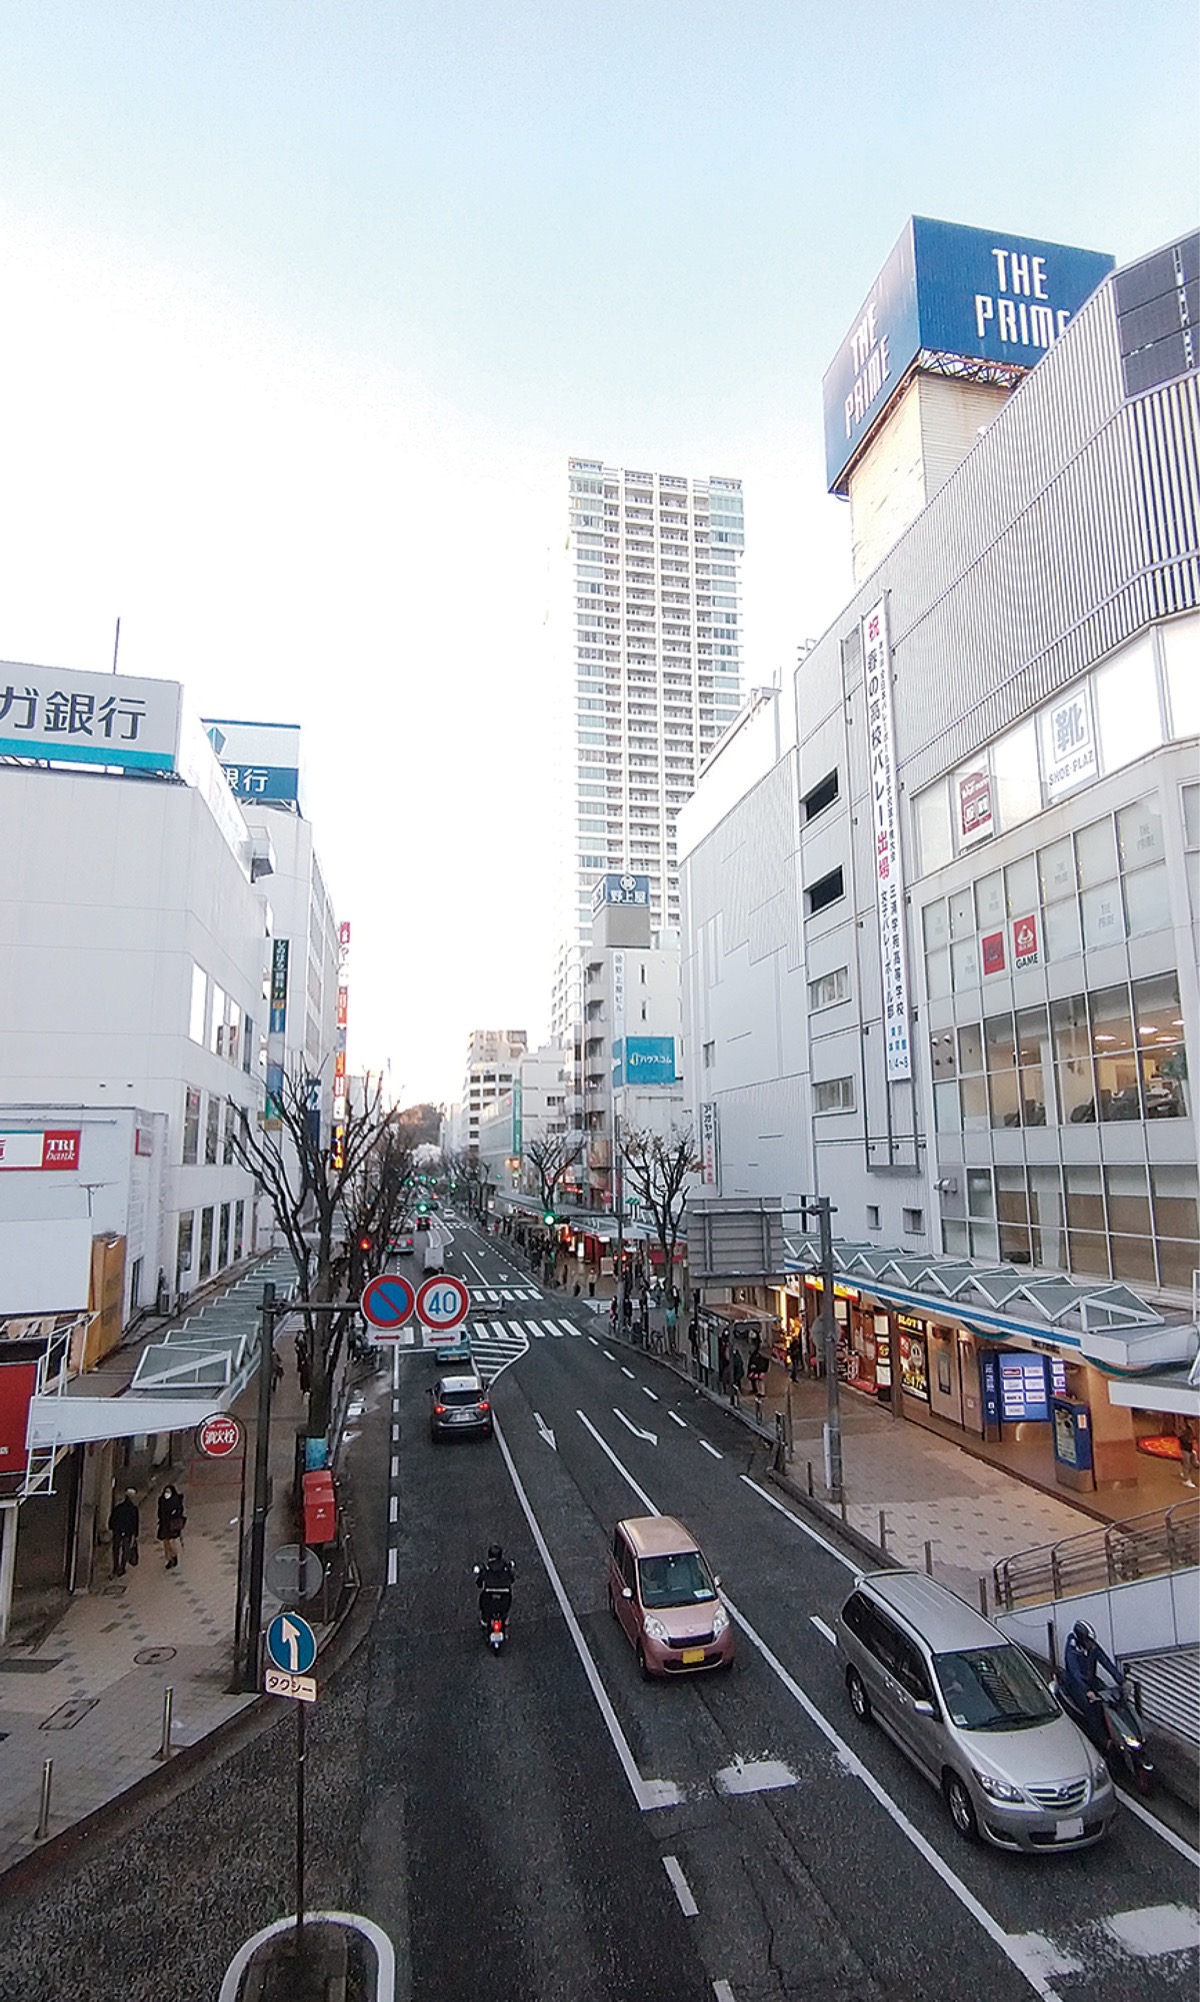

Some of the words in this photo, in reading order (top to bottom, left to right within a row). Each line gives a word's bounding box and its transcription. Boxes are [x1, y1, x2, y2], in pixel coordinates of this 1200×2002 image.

[991, 248, 1049, 300] THE
[849, 302, 879, 376] THE
[844, 334, 891, 439] PRIME
[0, 686, 147, 741] ガ銀行
[1055, 702, 1085, 752] 靴
[1015, 953, 1039, 970] GAME
[46, 1150, 75, 1161] bank
[47, 1139, 75, 1151] TRI
[428, 1290, 457, 1315] 40
[205, 1428, 235, 1445] 消火栓
[268, 1675, 314, 1694] タクシー
